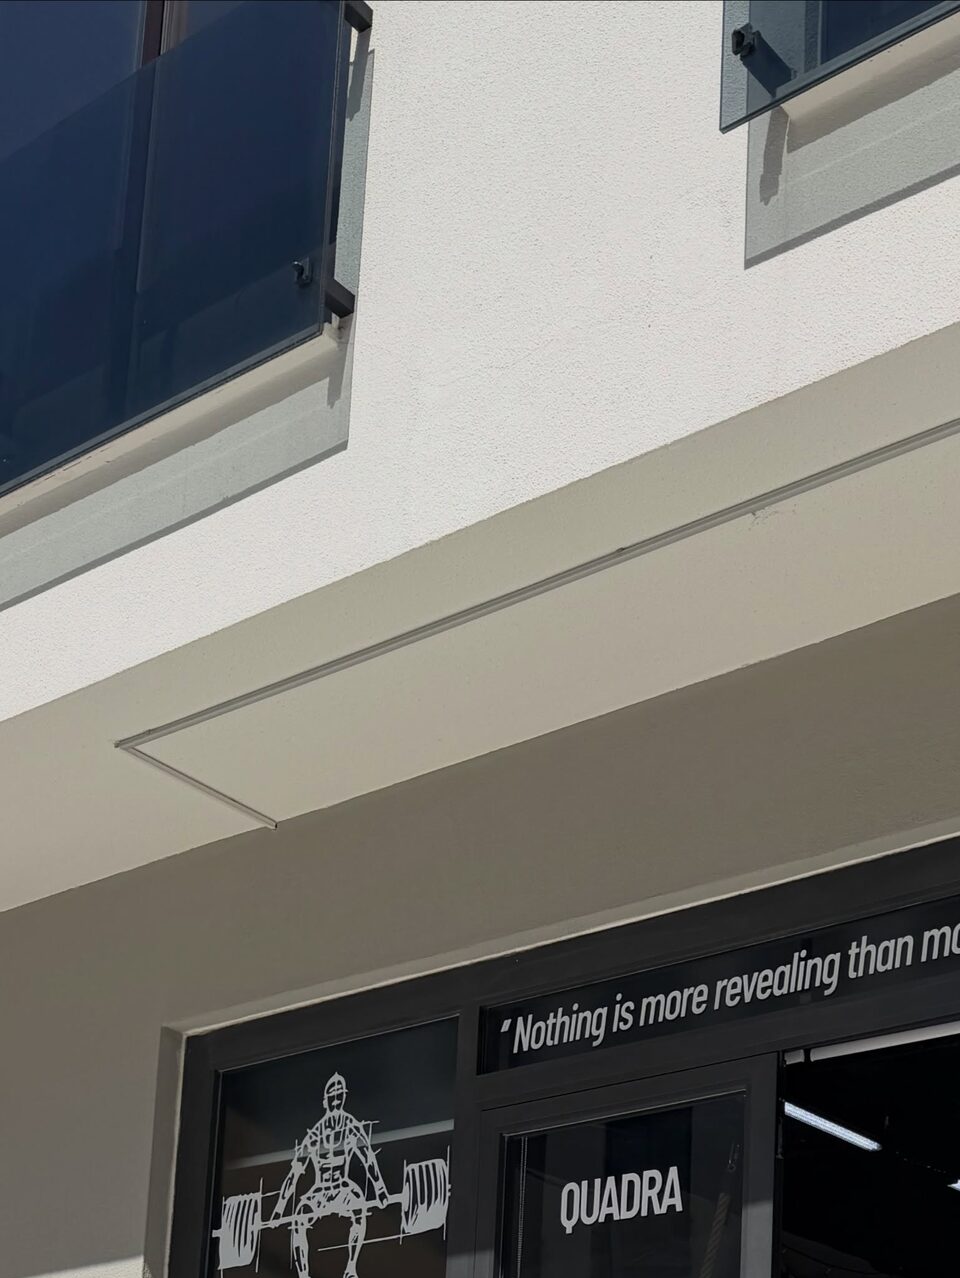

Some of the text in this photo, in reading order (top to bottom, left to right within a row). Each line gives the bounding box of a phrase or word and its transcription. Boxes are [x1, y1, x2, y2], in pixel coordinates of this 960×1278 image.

[612, 993, 635, 1033] is
[639, 983, 709, 1027] more
[713, 949, 841, 1010] revealing
[848, 935, 914, 979] than
[560, 1165, 683, 1234] QUADRA
